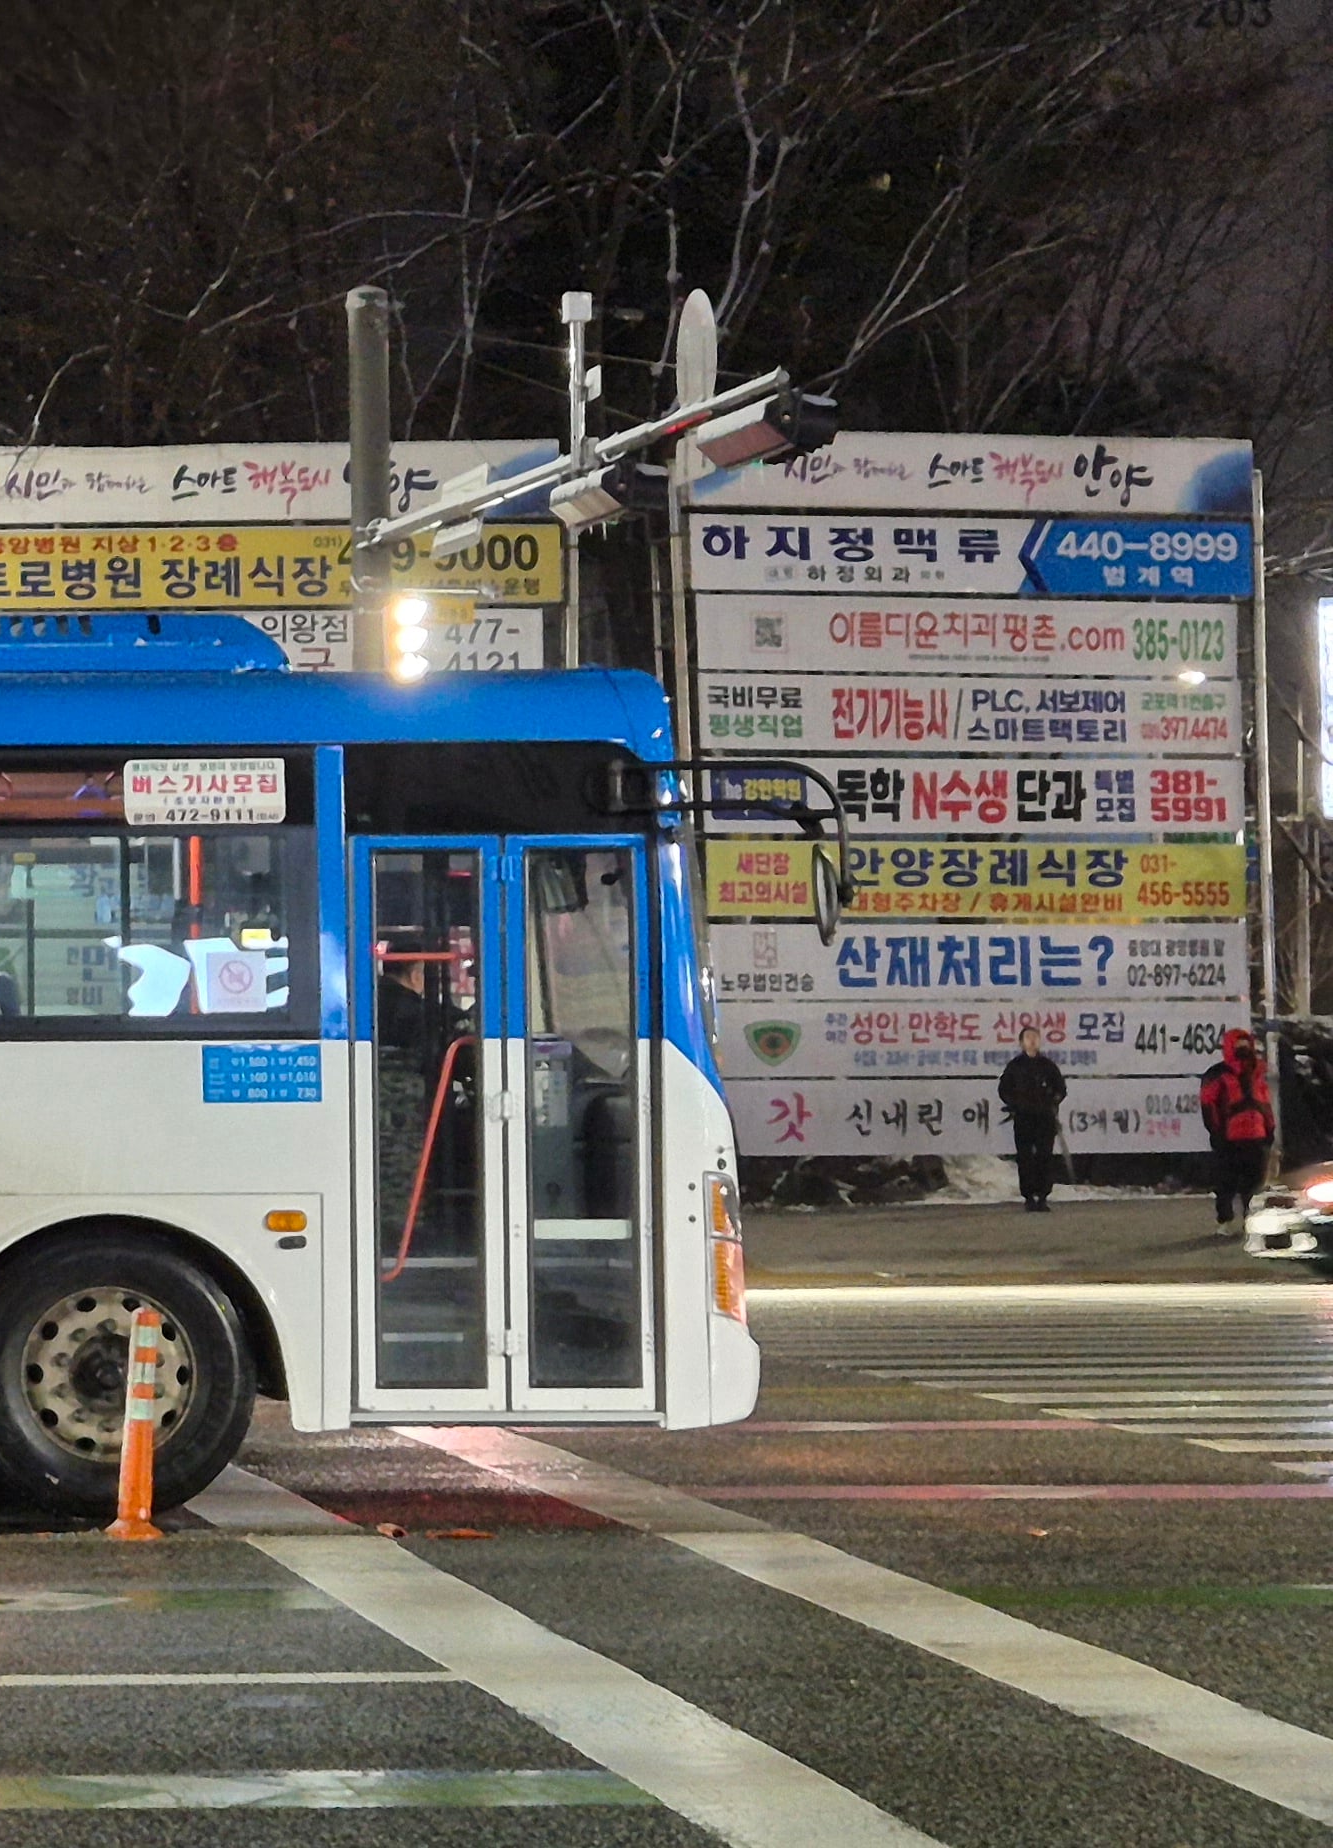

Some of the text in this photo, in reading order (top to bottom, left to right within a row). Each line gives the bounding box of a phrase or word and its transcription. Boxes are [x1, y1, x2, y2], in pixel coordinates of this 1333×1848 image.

[172, 463, 238, 501] 스마트
[242, 459, 331, 516] 행복도시
[927, 453, 984, 489] 스마트
[989, 451, 1066, 505] 행복도시
[1073, 444, 1155, 508] 안양
[92, 533, 141, 555] 지상
[702, 523, 1239, 563] 하지정맥류 440-8999
[159, 554, 333, 600] 장례식장
[1102, 565, 1194, 588] 범계역
[261, 613, 349, 644] 의왕점
[1133, 618, 1225, 662] 385-0123
[707, 685, 803, 709] 국비무료
[971, 688, 1126, 714] PLC, 서보제어
[708, 714, 803, 739] 평생직업
[832, 686, 948, 741] 전기기능사
[967, 718, 1127, 743] 스마트팩토리
[132, 774, 279, 795] 버스기사모집
[837, 767, 1087, 824] 독학 N수생 단과
[1149, 769, 1218, 795] 381-
[1095, 797, 1136, 823] 모집
[1150, 797, 1227, 823] 5991
[736, 851, 791, 876] 새단장
[848, 848, 1129, 888] 안양장례식장
[1139, 854, 1178, 874] 031-
[1136, 880, 1231, 908] 456-5555
[835, 934, 1115, 988] 산재처리는?
[720, 972, 815, 993] 노무법인건승
[1126, 962, 1227, 988] 02-897-6224
[1075, 1011, 1126, 1044] 모집
[765, 1091, 814, 1144] 갓
[845, 1097, 945, 1137] 신내린
[1067, 1107, 1141, 1135] (3개월)
